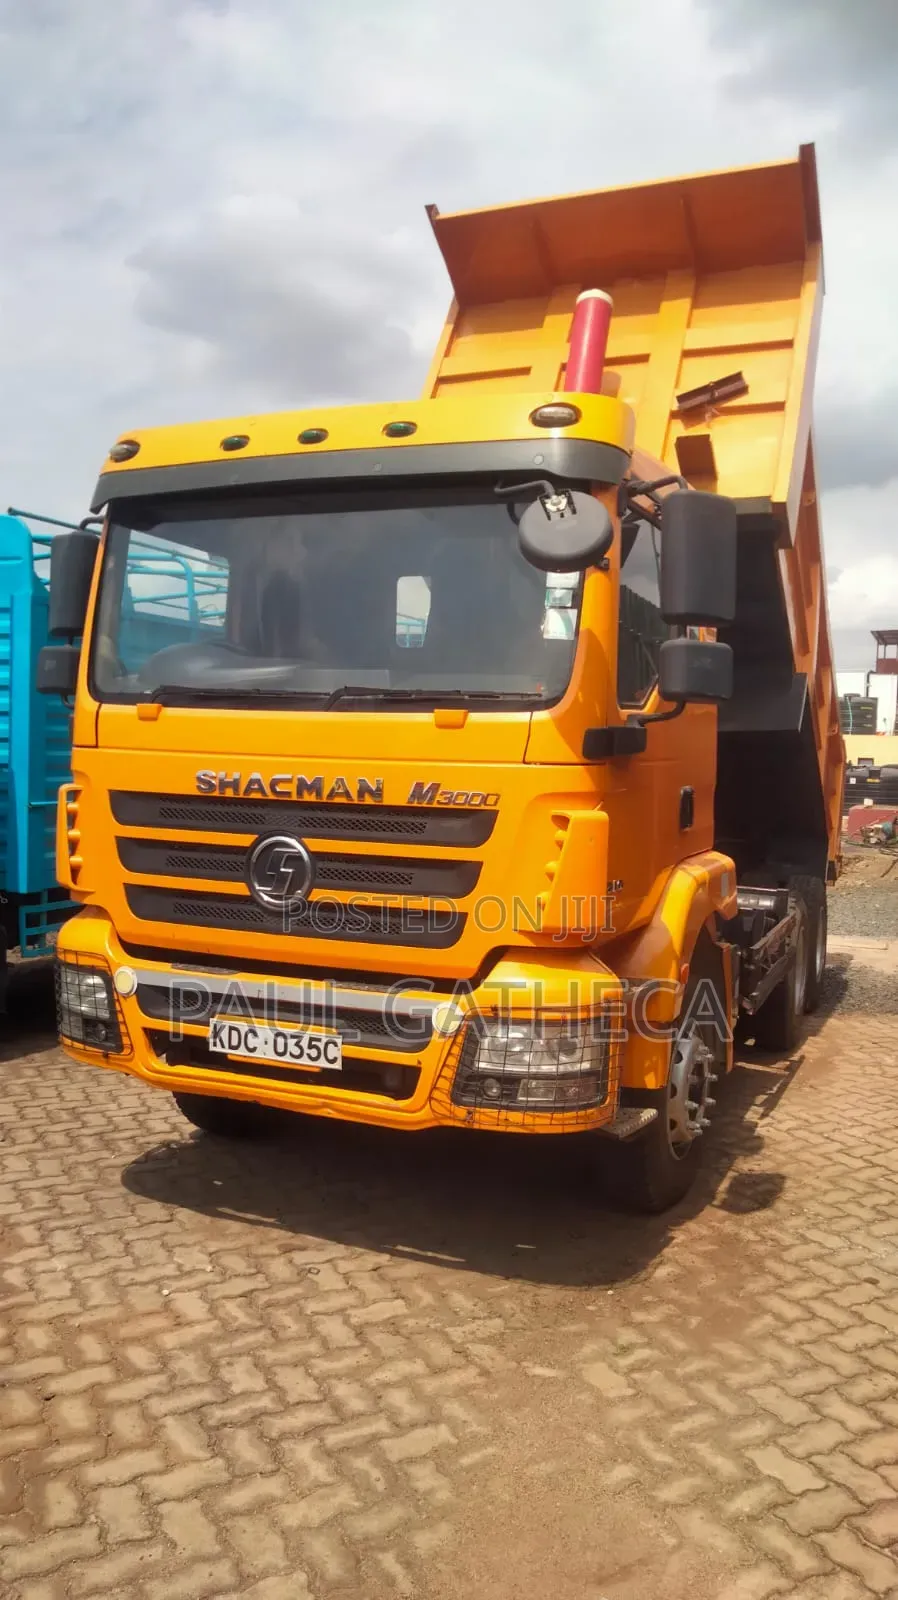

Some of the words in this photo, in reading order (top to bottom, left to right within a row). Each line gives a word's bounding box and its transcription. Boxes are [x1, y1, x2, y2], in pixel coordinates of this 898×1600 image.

[195, 769, 384, 803] SHACMAN
[406, 780, 501, 807] M3000
[212, 1022, 258, 1054] KDC
[273, 1031, 339, 1065] 035C
